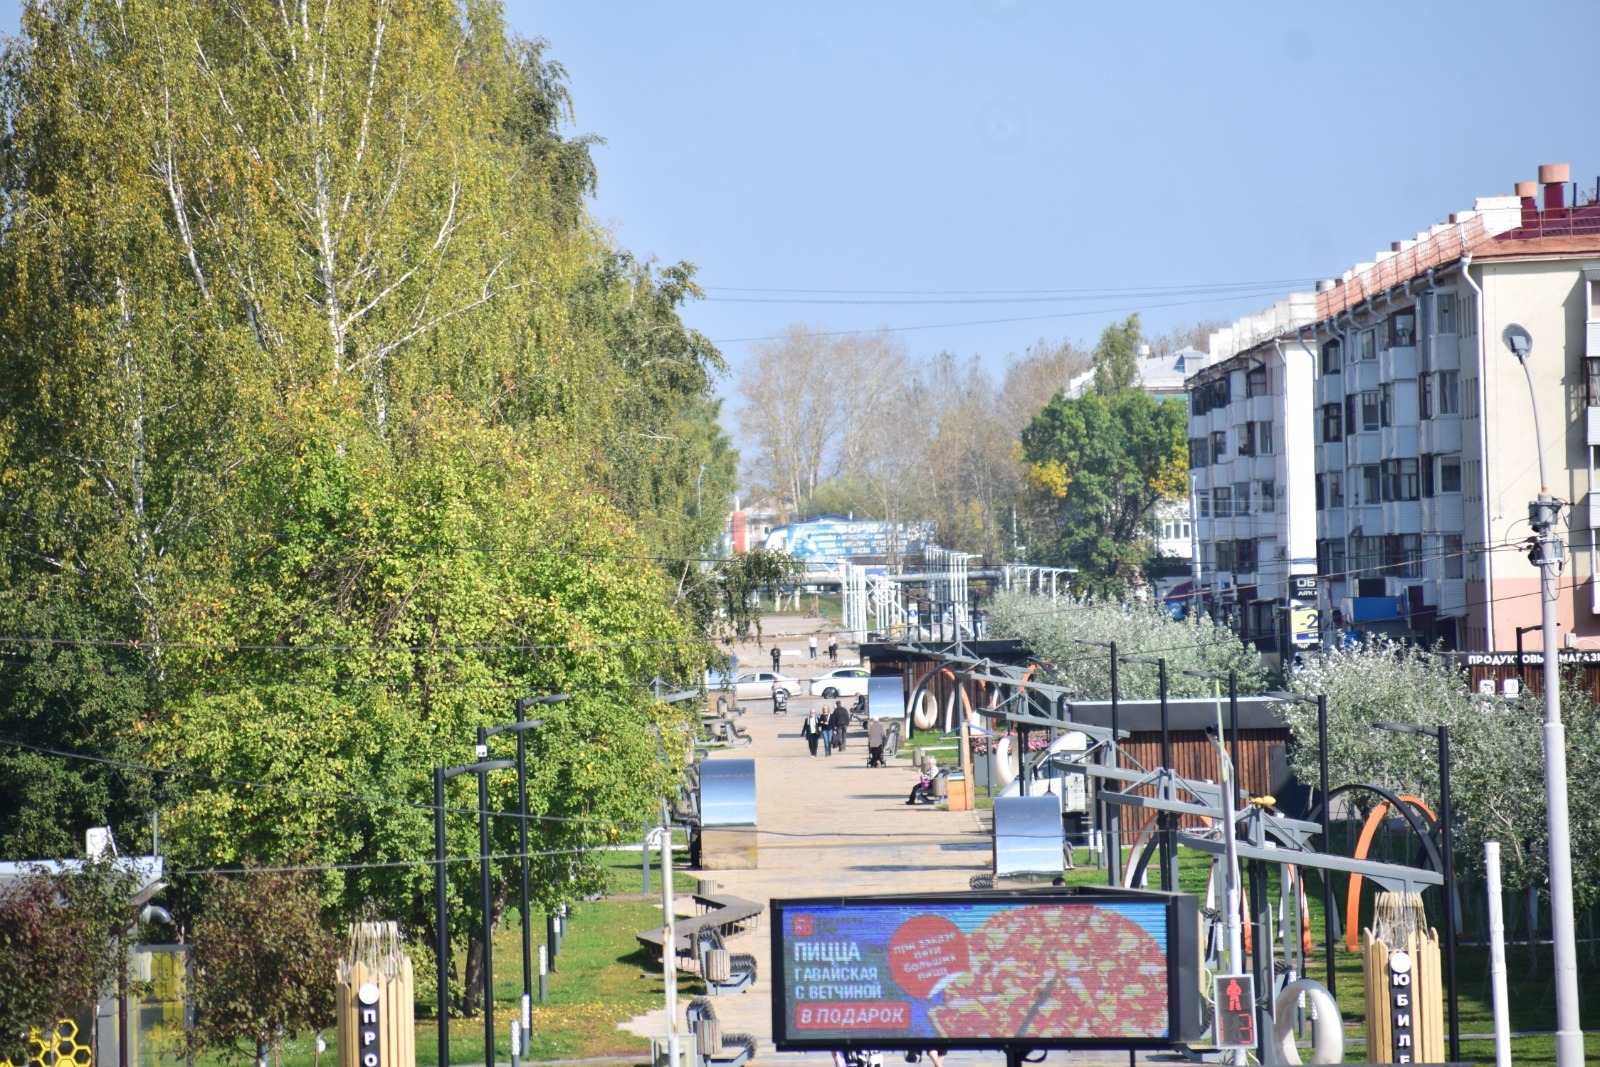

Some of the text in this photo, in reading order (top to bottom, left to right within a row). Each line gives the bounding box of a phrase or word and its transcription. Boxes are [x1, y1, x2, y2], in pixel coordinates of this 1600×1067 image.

[1296, 577, 1318, 588] ОБ
[794, 942, 861, 965] ПИЦЦА
[795, 963, 878, 982] ГАВАЙСКАЯ
[904, 954, 957, 974] больших
[795, 982, 882, 1000] С ВЕТЧИНОЙ
[801, 1008, 904, 1027] В ПОДАРОК
[1220, 1013, 1253, 1044] 13
